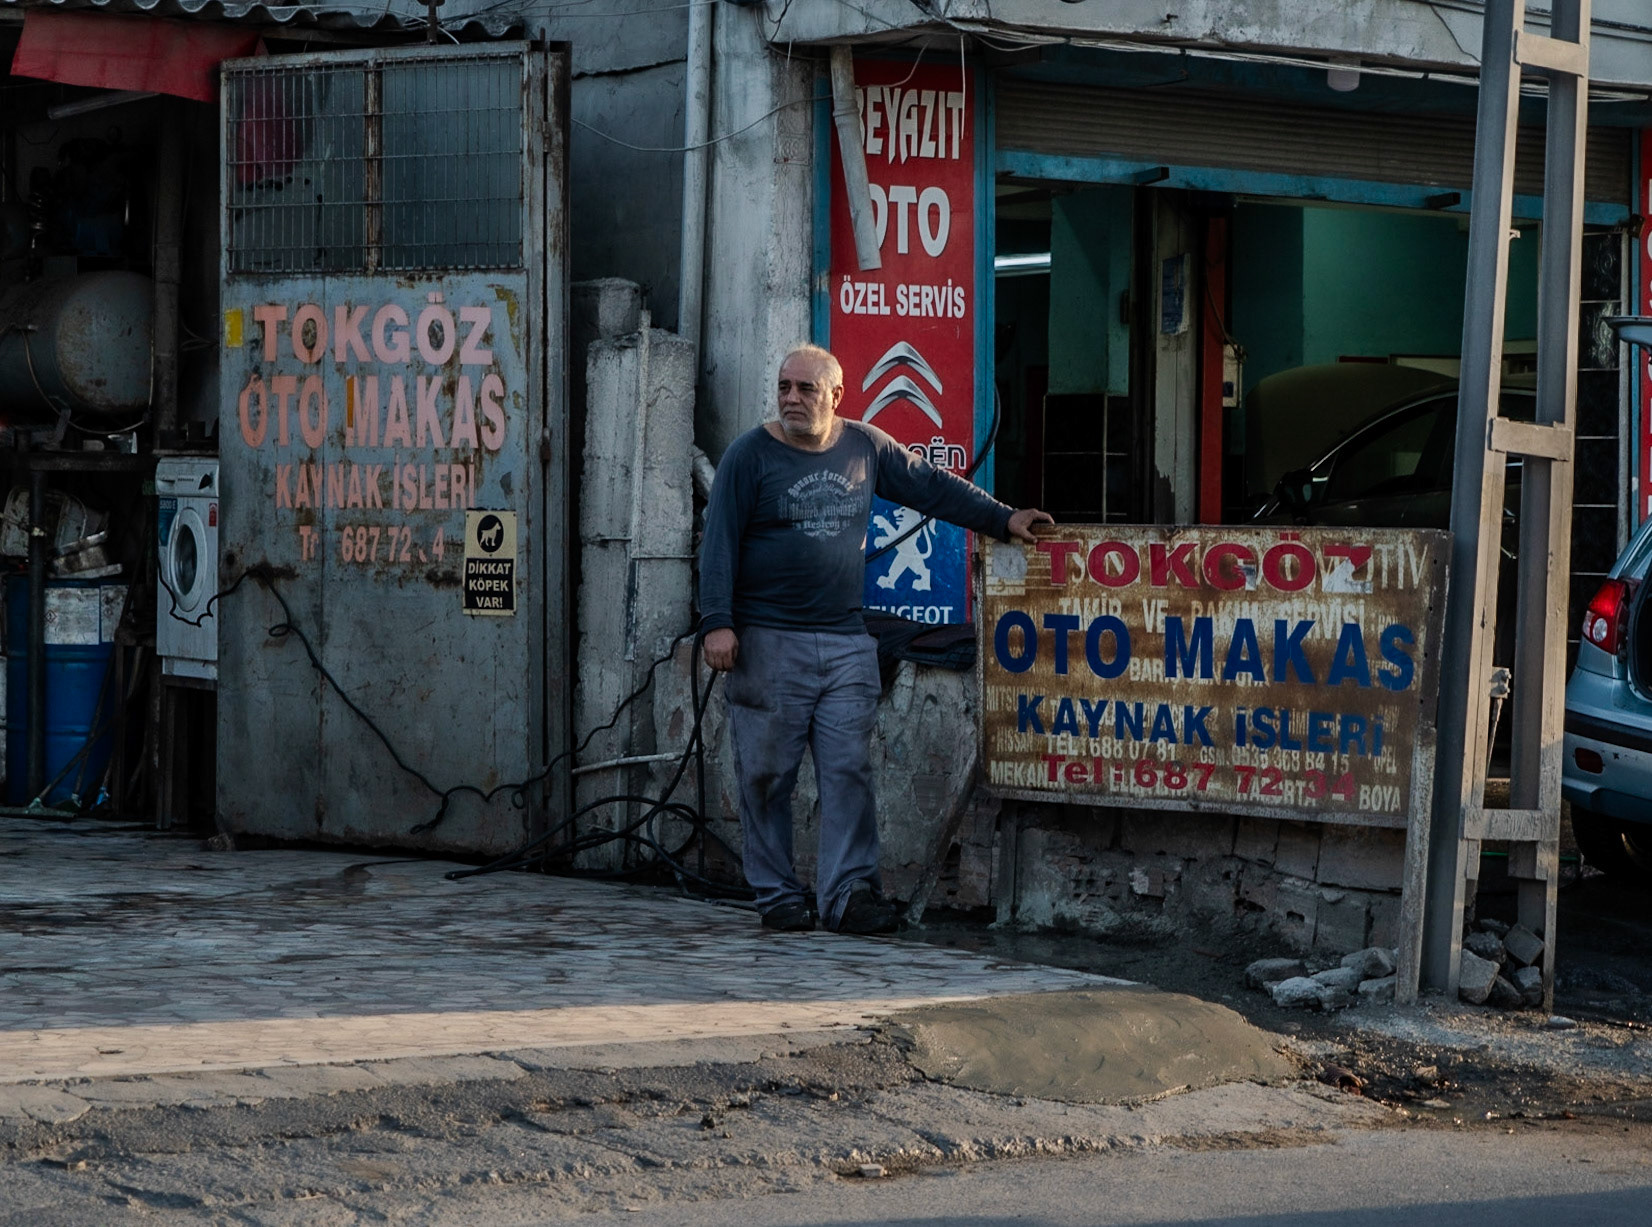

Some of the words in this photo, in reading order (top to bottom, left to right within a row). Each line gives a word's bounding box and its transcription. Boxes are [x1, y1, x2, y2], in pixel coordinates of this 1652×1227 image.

[840, 275, 890, 314] ÖZEL
[896, 278, 966, 319] SERVİS
[254, 291, 493, 366] TOKGÖZ
[238, 373, 329, 449] OTO
[345, 373, 506, 451] MAKAS
[276, 463, 384, 510] KAYNAK
[342, 525, 381, 562] 687
[387, 526, 412, 562] 72
[1035, 532, 1373, 594] TOKGÖZ
[468, 560, 511, 575] DİKKAT
[469, 578, 509, 592] KÖPEK
[476, 596, 503, 608] VAR!
[994, 610, 1132, 680] OTO
[1164, 615, 1415, 692] MAKAS
[1017, 694, 1215, 747] KAYNAK
[1358, 784, 1402, 812] BOYA
